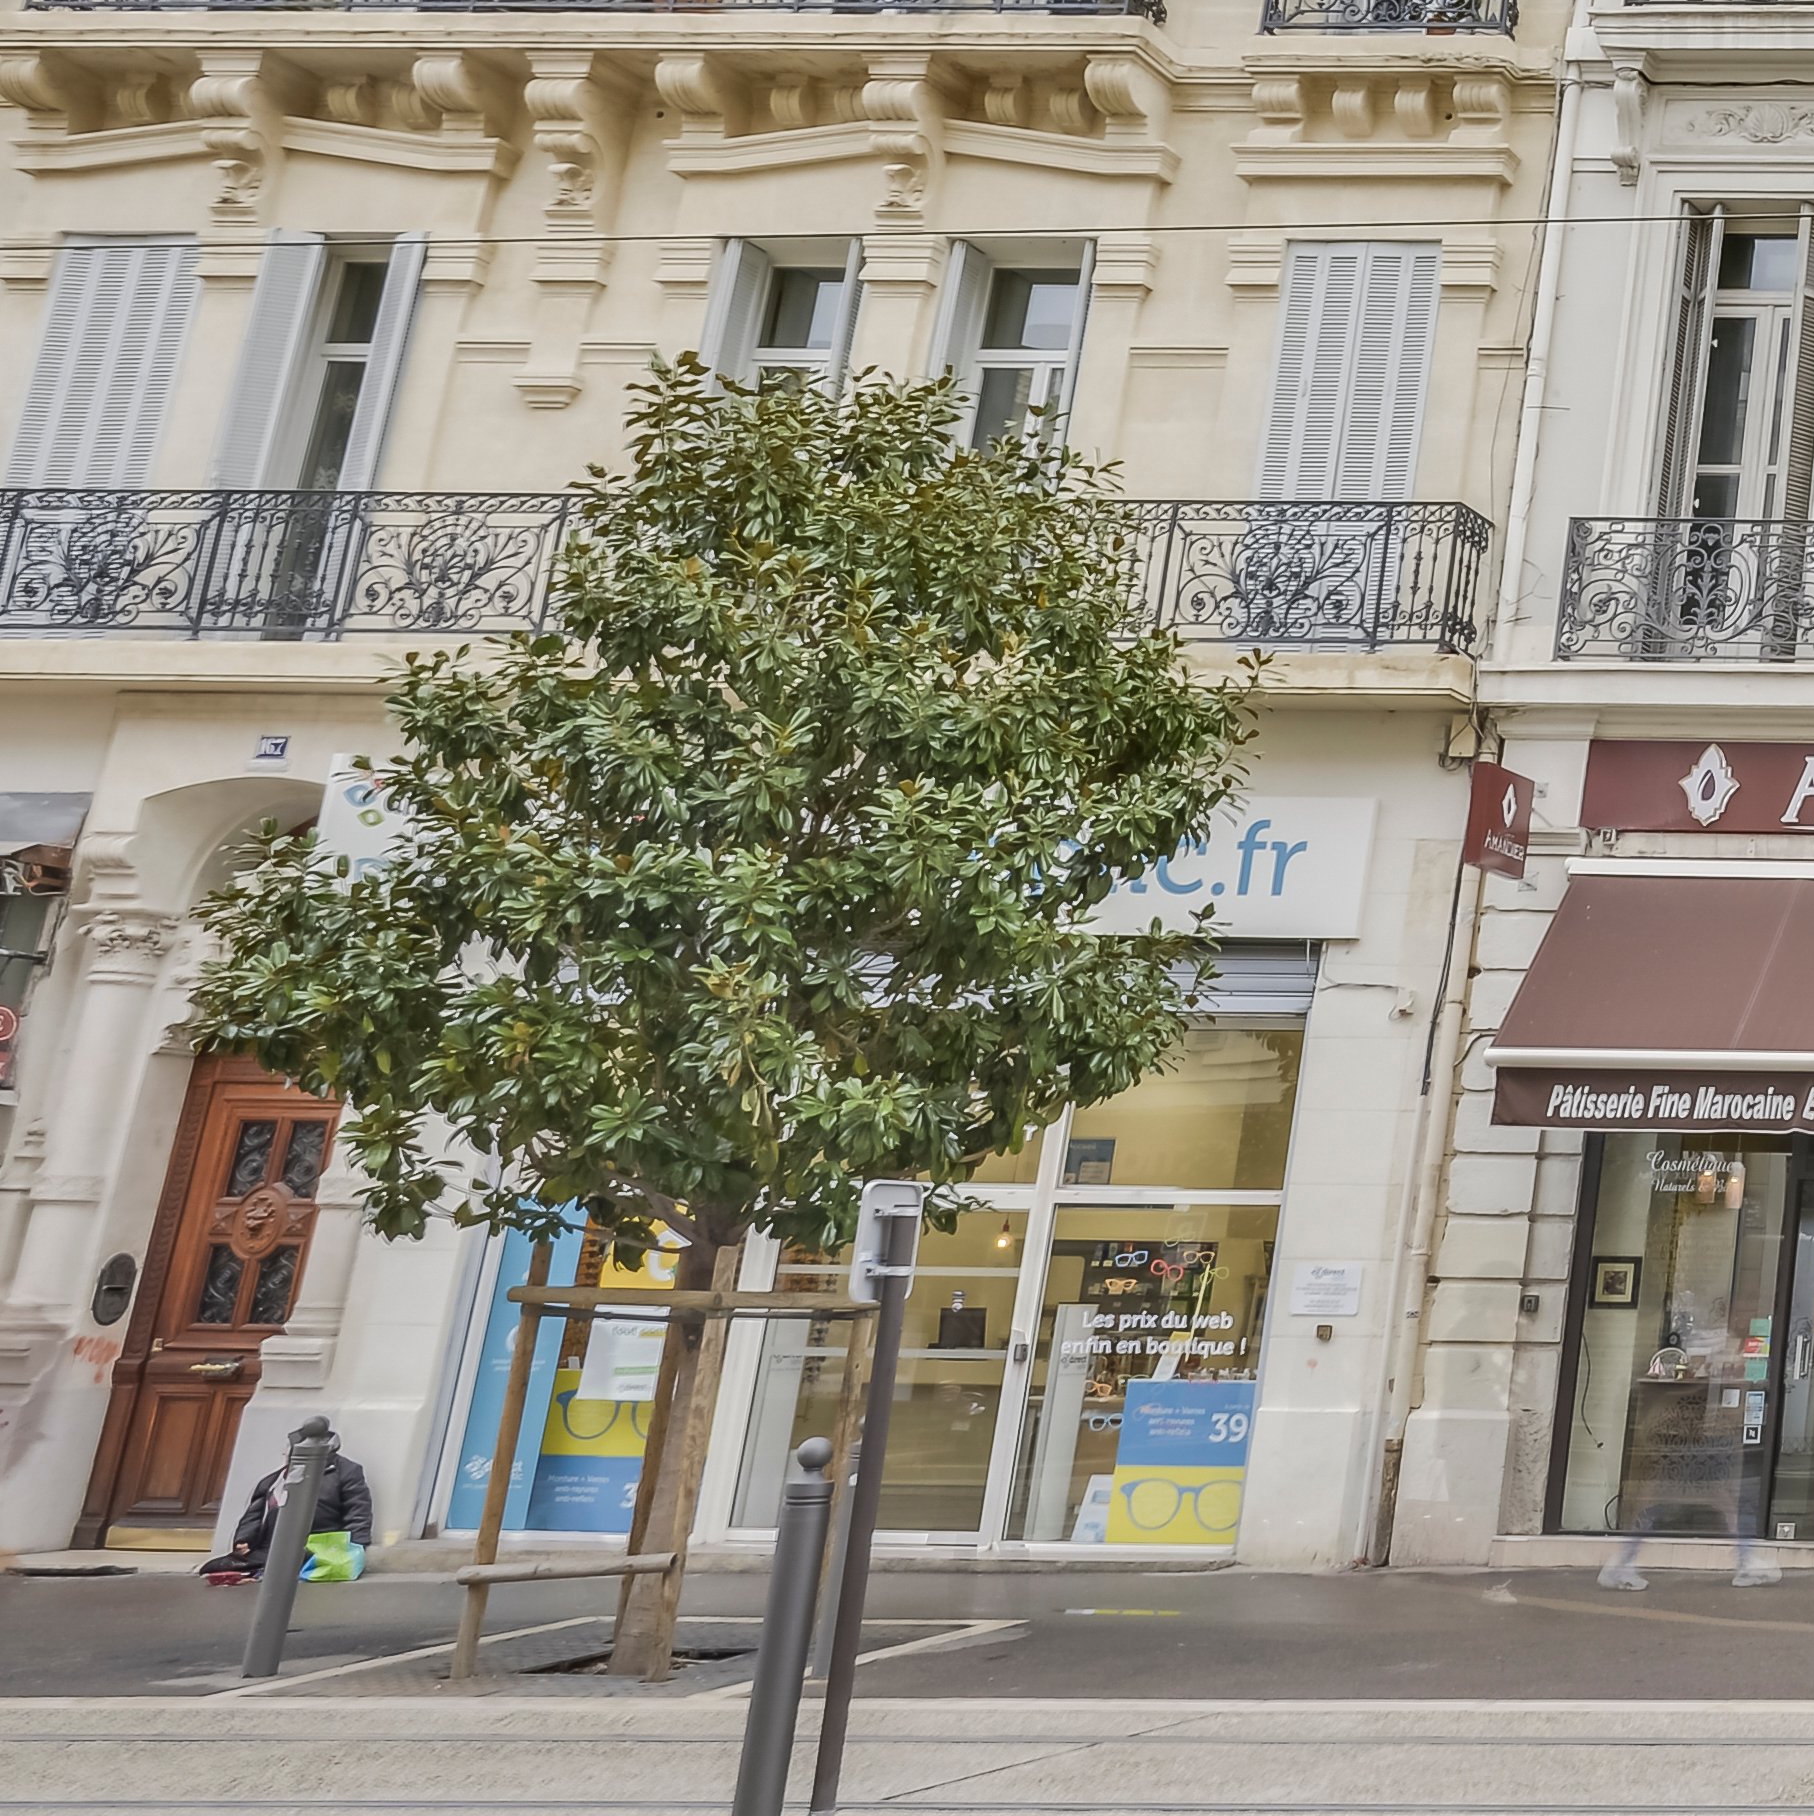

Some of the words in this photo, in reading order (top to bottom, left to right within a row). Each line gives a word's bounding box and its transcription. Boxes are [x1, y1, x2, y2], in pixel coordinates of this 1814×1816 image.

[257, 736, 287, 756] 167
[1547, 1084, 1645, 1119] Pâtisserie
[1648, 1085, 1691, 1119] Fine
[1693, 1086, 1796, 1120] Marocaine
[1081, 1311, 1116, 1329] Les
[1118, 1310, 1159, 1332] prix
[1160, 1310, 1187, 1329] du
[1193, 1311, 1234, 1330] web
[1061, 1336, 1112, 1354] enfin
[1115, 1340, 1142, 1354] en
[1146, 1336, 1236, 1358] boutique
[1208, 1412, 1249, 1443] 39
